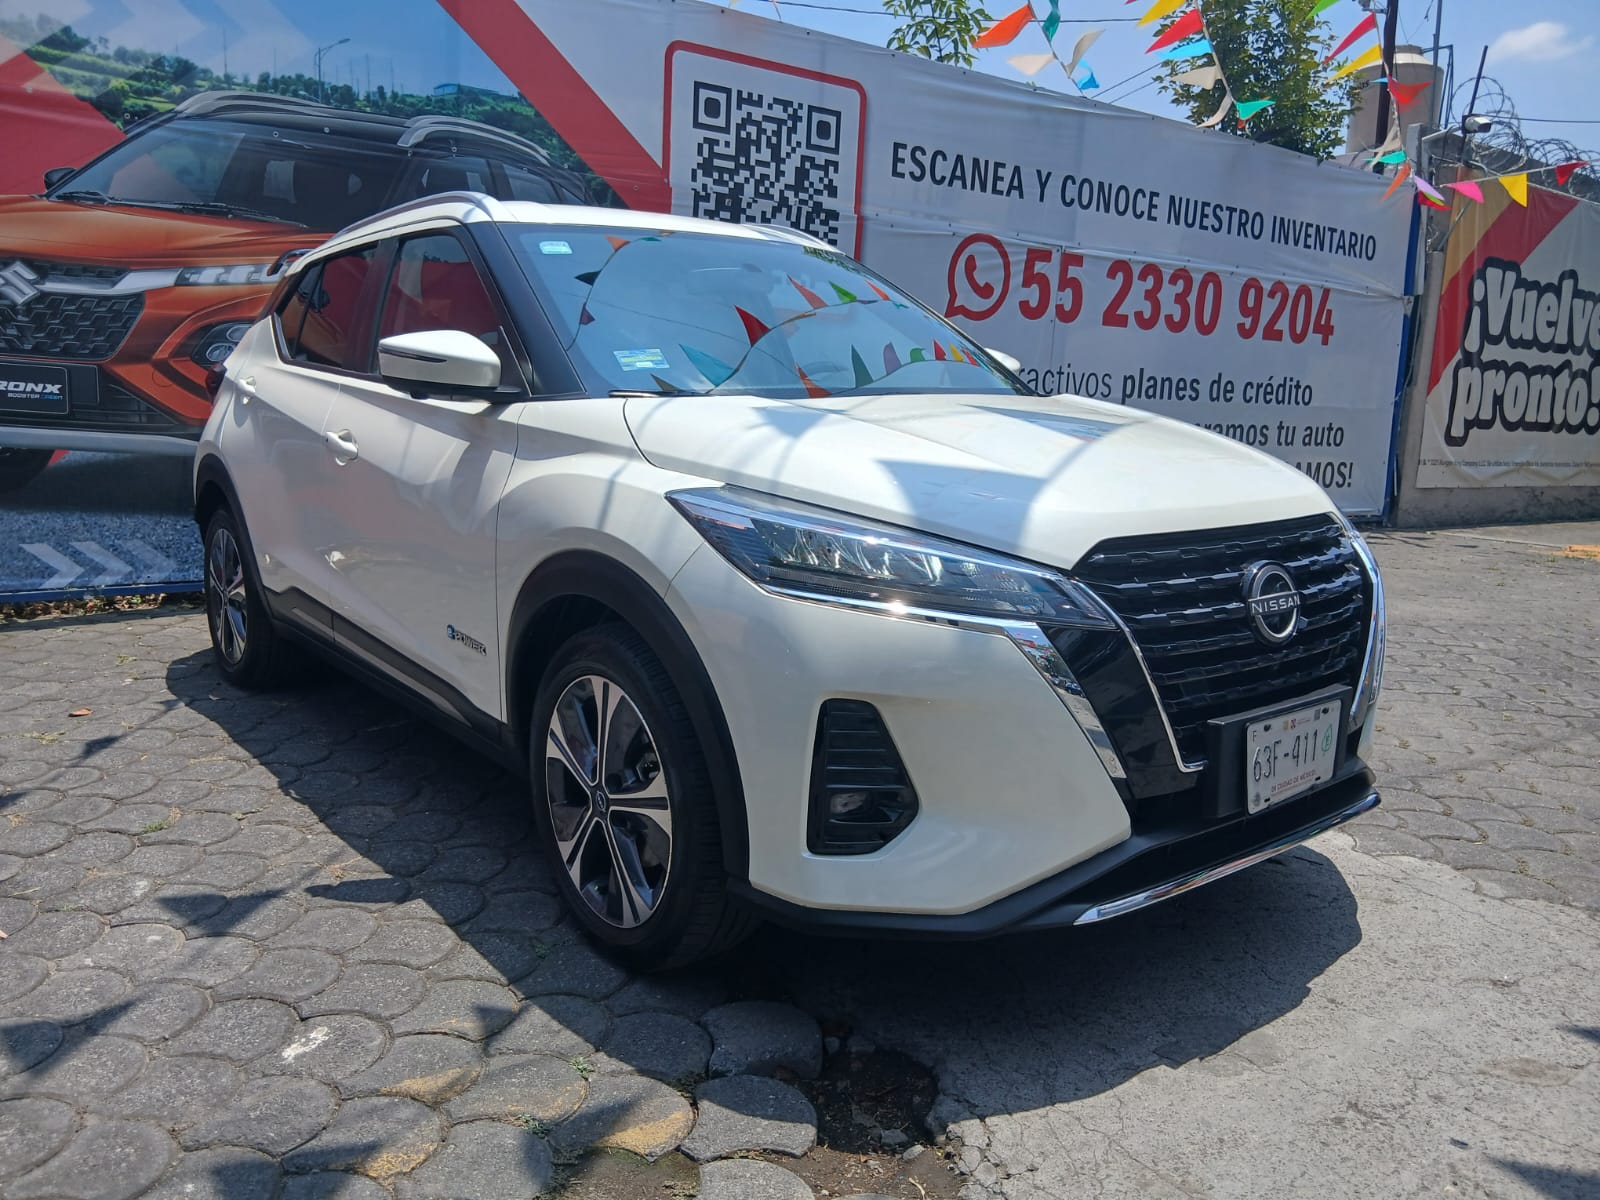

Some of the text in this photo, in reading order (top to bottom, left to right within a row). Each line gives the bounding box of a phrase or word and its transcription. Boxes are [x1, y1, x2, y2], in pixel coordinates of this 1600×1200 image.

[891, 142, 1376, 261] ESCANEA Y CONOCE NUESTRO INVENTARIO
[1019, 248, 1334, 346] 55 2330 9204
[1121, 368, 1200, 405] planes
[1209, 373, 1234, 403] de
[1243, 376, 1313, 406] crédito
[1446, 360, 1600, 446] pronto!
[1276, 420, 1296, 446] tu
[1302, 422, 1344, 447] auto
[1251, 593, 1300, 613] NISSAN
[1253, 728, 1318, 782] 63F-411
